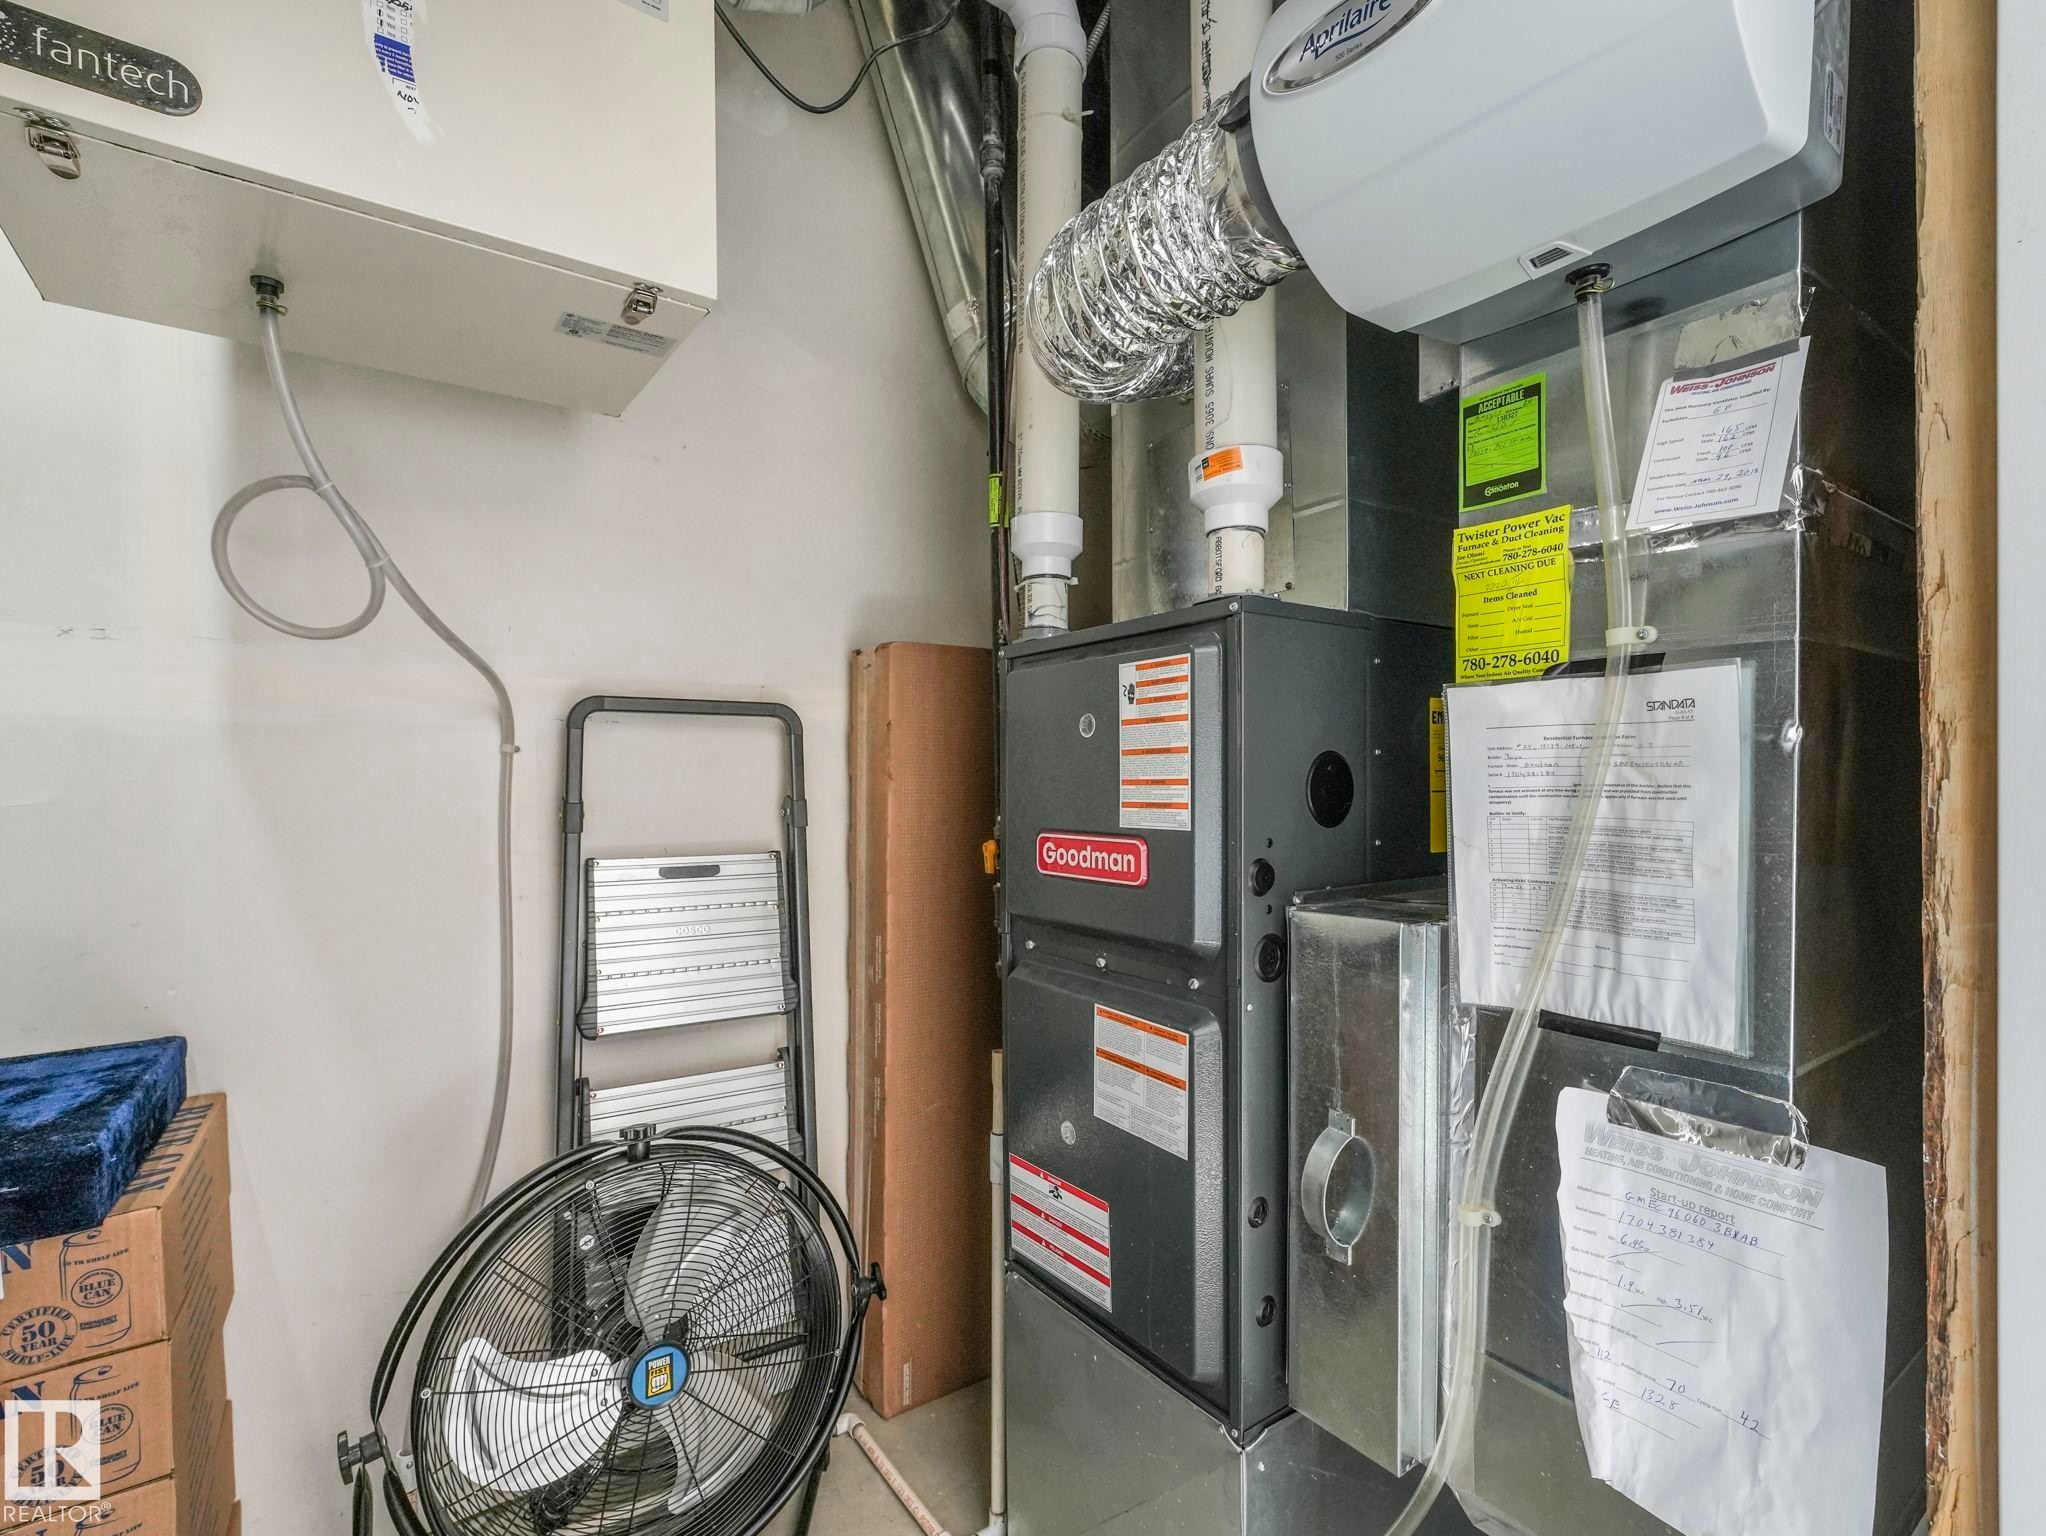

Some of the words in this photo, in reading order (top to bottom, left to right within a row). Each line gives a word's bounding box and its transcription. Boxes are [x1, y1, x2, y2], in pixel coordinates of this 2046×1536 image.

[32, 26, 189, 104] fantech
[1478, 389, 1525, 414] ACCEPTABLE
[1205, 401, 1215, 427] 3065
[1484, 481, 1519, 497] Edmonton
[1457, 528, 1500, 543] Twister
[1503, 520, 1541, 535] Power
[1544, 513, 1566, 525] Vac
[1457, 540, 1490, 553] Furnace
[1491, 538, 1499, 546] &
[1501, 534, 1522, 544] Duct
[1523, 525, 1565, 540] Cleaning
[1502, 542, 1564, 562] 780-278-6040
[1464, 570, 1486, 581] NEXT
[1487, 562, 1535, 577] CLEANING
[1536, 557, 1557, 568] DUE
[1483, 596, 1504, 604] Items
[1505, 588, 1538, 600] Cleaned
[1462, 649, 1560, 672] 780-278-6040
[1646, 698, 1696, 711] STANDATA
[1042, 841, 1136, 873] Goodman
[675, 925, 711, 936] COSCO
[1583, 1119, 1664, 1162] WEISS
[1677, 1153, 1824, 1209] JOHNSON
[1584, 1145, 1626, 1166] HEATING,
[1627, 1157, 1644, 1170] AIR
[1646, 1163, 1714, 1191] CONDITIONING
[1714, 1184, 1723, 1193] &
[1725, 1187, 1757, 1205] HOME
[1758, 1197, 1815, 1221] COMFORT
[1649, 1187, 1696, 1210] Start-up
[1698, 1204, 1736, 1224] report
[86, 1254, 111, 1265] SHELF
[78, 1277, 116, 1294] BLUE
[82, 1287, 113, 1301] CAN
[2, 1306, 73, 1337] CERTIFIED
[21, 1320, 56, 1344] 50
[2, 1332, 76, 1365] SHELF-LIFE
[20, 1337, 58, 1353] YEAR
[649, 1355, 671, 1371] POWER
[651, 1366, 667, 1377] FIST
[1666, 1378, 1686, 1394] 70
[1741, 1410, 1759, 1433] 42
